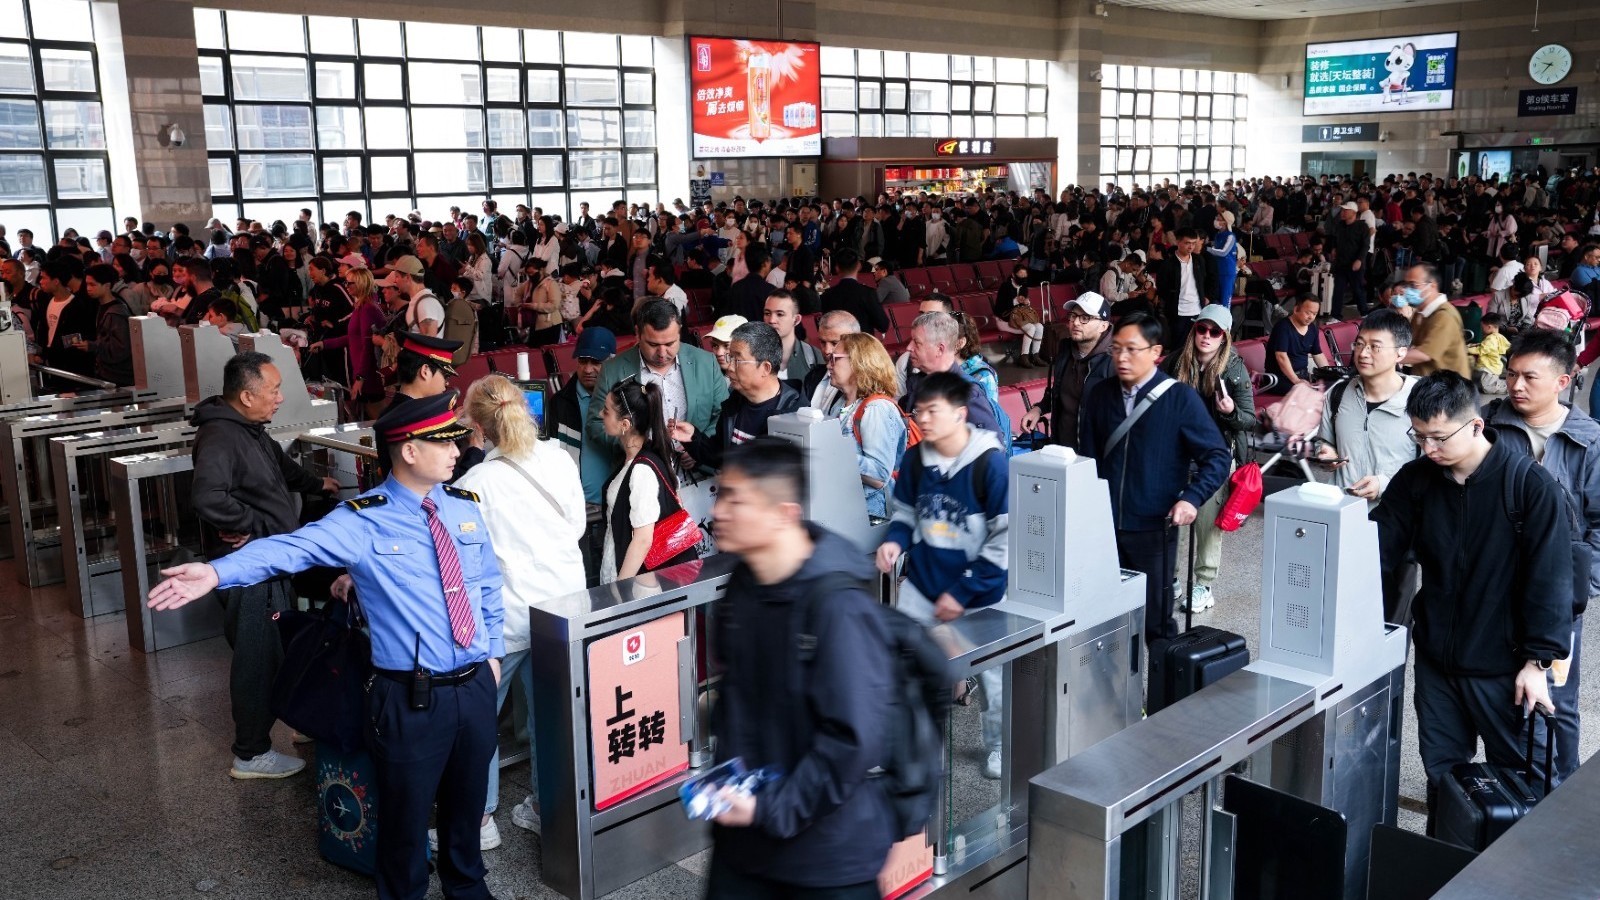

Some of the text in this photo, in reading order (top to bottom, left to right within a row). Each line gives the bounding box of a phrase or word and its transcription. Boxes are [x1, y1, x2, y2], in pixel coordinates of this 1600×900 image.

[1526, 93, 1570, 104] 第9候车室
[1333, 126, 1362, 135] 男卫生间
[606, 685, 635, 726] 上
[608, 710, 665, 765] 转转
[610, 755, 667, 794] ZHUAN
[881, 853, 927, 894] HUAN
